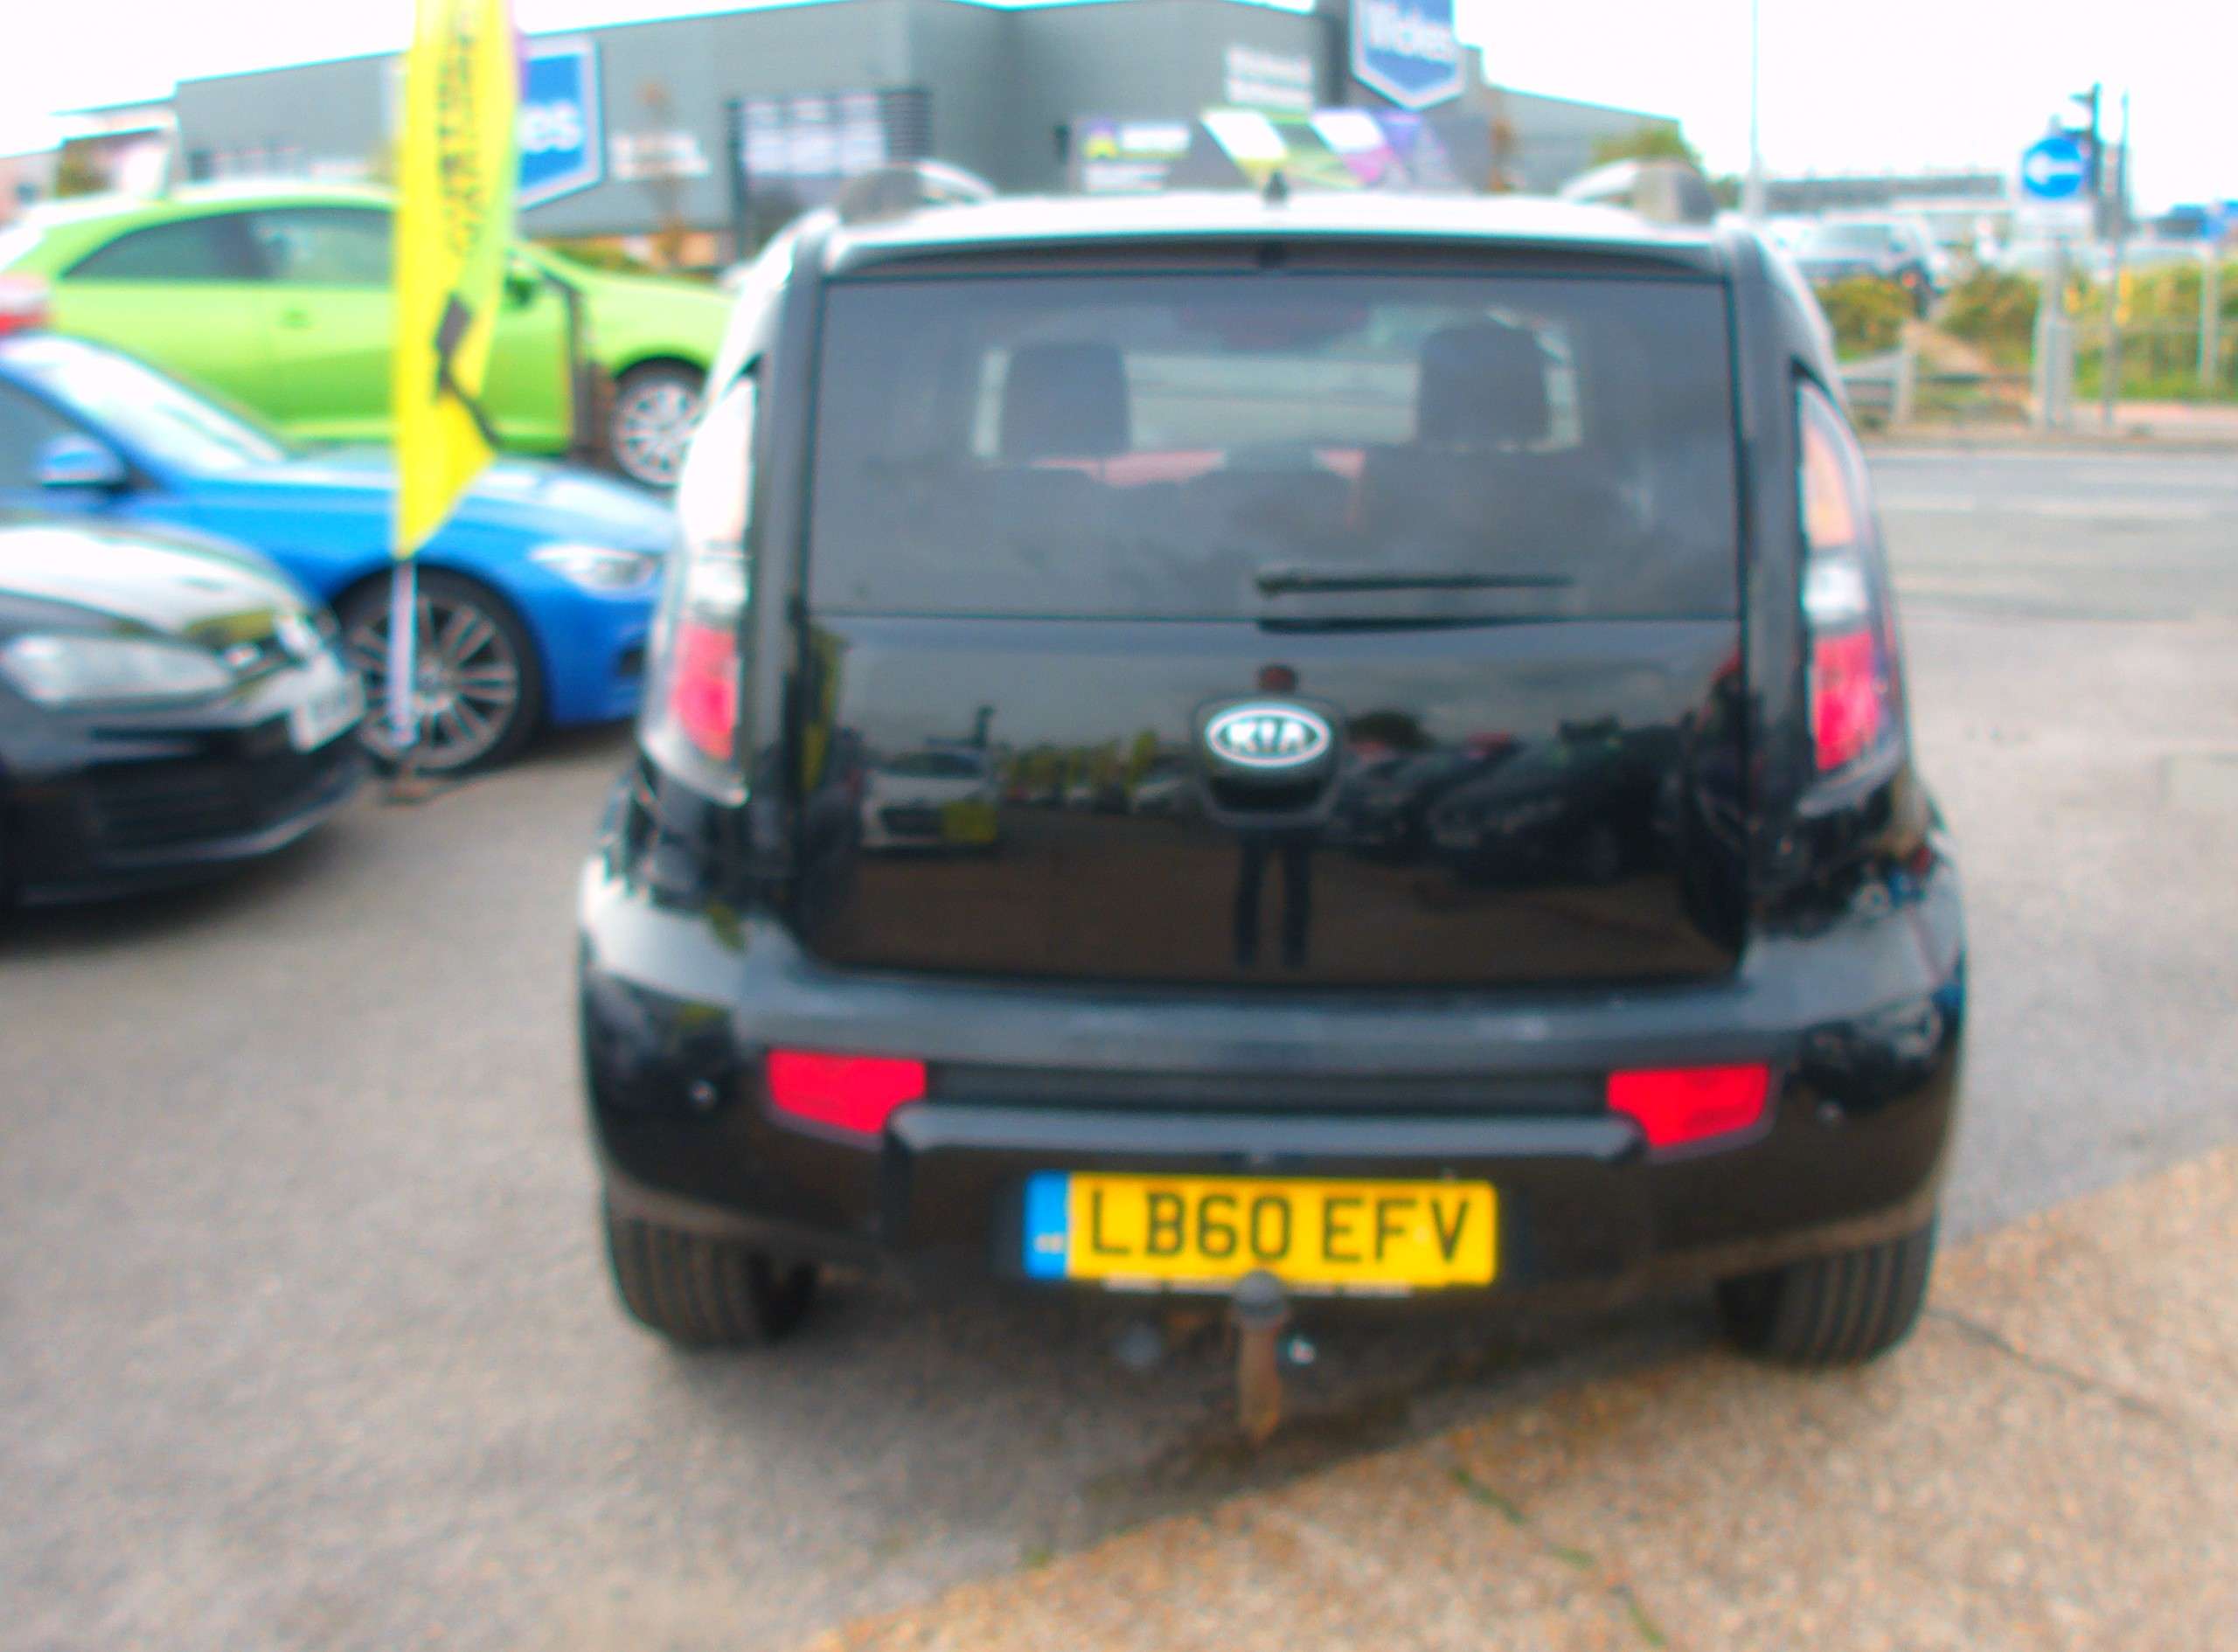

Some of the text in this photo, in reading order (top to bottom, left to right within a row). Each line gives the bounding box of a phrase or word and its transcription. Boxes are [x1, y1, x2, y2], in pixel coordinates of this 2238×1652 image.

[1228, 718, 1307, 753] KIA
[1089, 1188, 1470, 1265] LB60 EFV
